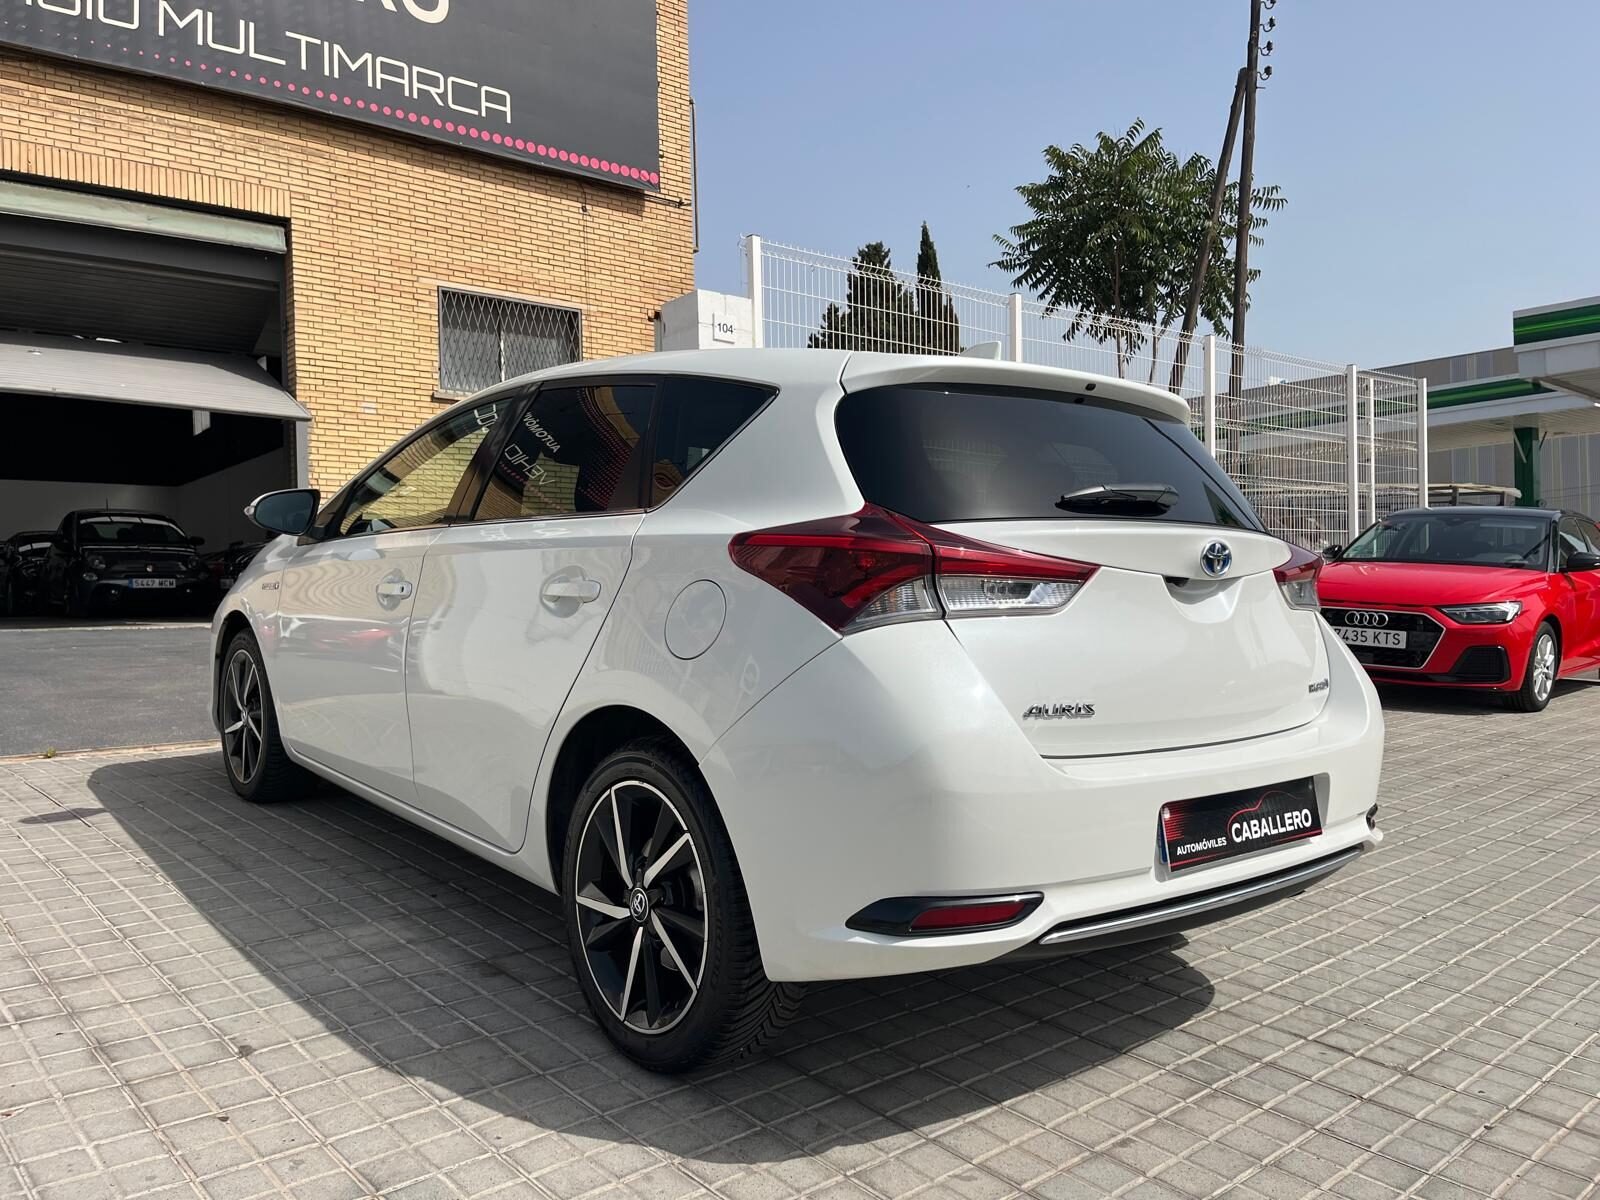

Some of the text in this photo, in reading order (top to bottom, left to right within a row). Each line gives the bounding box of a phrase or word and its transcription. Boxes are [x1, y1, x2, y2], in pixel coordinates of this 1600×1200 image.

[158, 0, 511, 123] MULTIMARCA
[717, 323, 734, 335] 104
[1373, 631, 1401, 646] KTS
[1022, 702, 1096, 720] AURIS
[1176, 808, 1312, 856] AUTOMÓVILES CABALLERO
